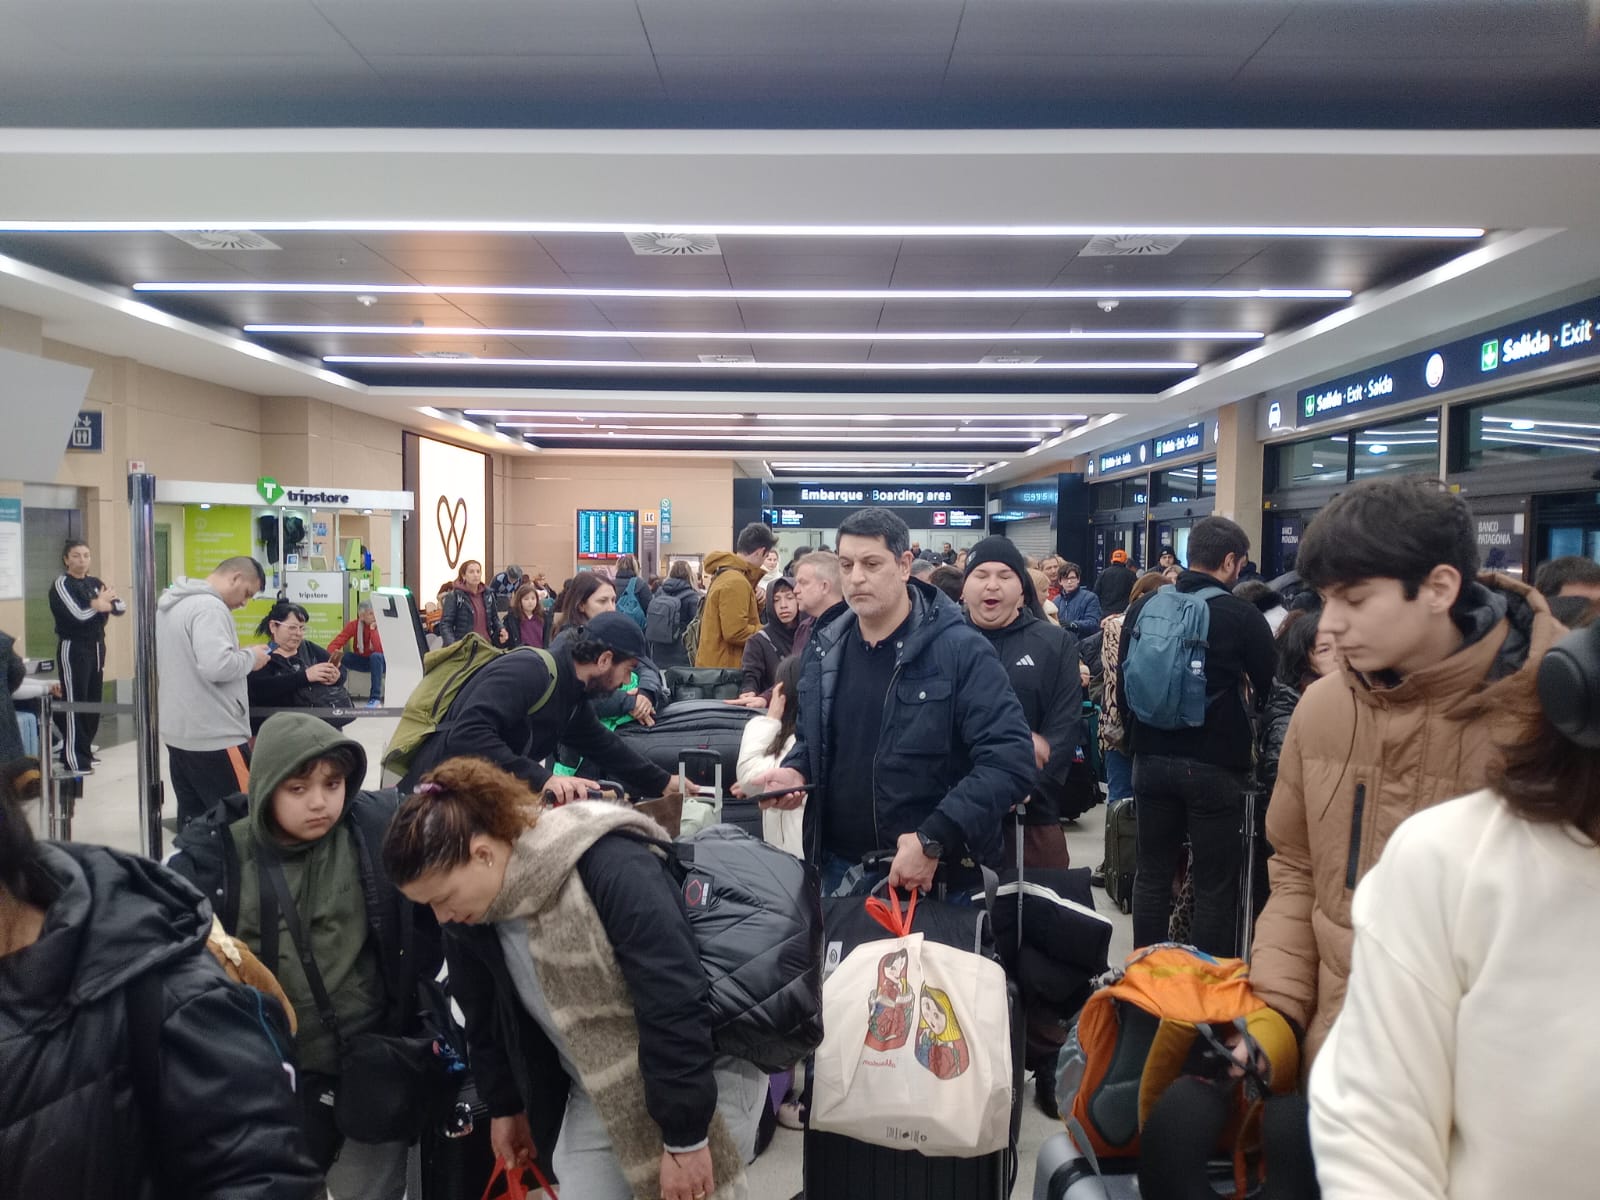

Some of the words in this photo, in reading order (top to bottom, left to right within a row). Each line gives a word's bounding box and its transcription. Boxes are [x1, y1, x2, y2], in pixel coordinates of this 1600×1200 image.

[1502, 330, 1551, 362] Salida
[1560, 319, 1593, 347] Exit
[1316, 389, 1342, 411] Salida
[1347, 384, 1363, 403] Exit
[287, 489, 349, 505] tripstore
[801, 489, 864, 503] Embarque
[872, 490, 924, 503] Boarding
[927, 491, 952, 501] area
[1478, 520, 1499, 532] BANCO
[1477, 533, 1511, 545] PATAGONIA
[299, 592, 328, 600] tripstore
